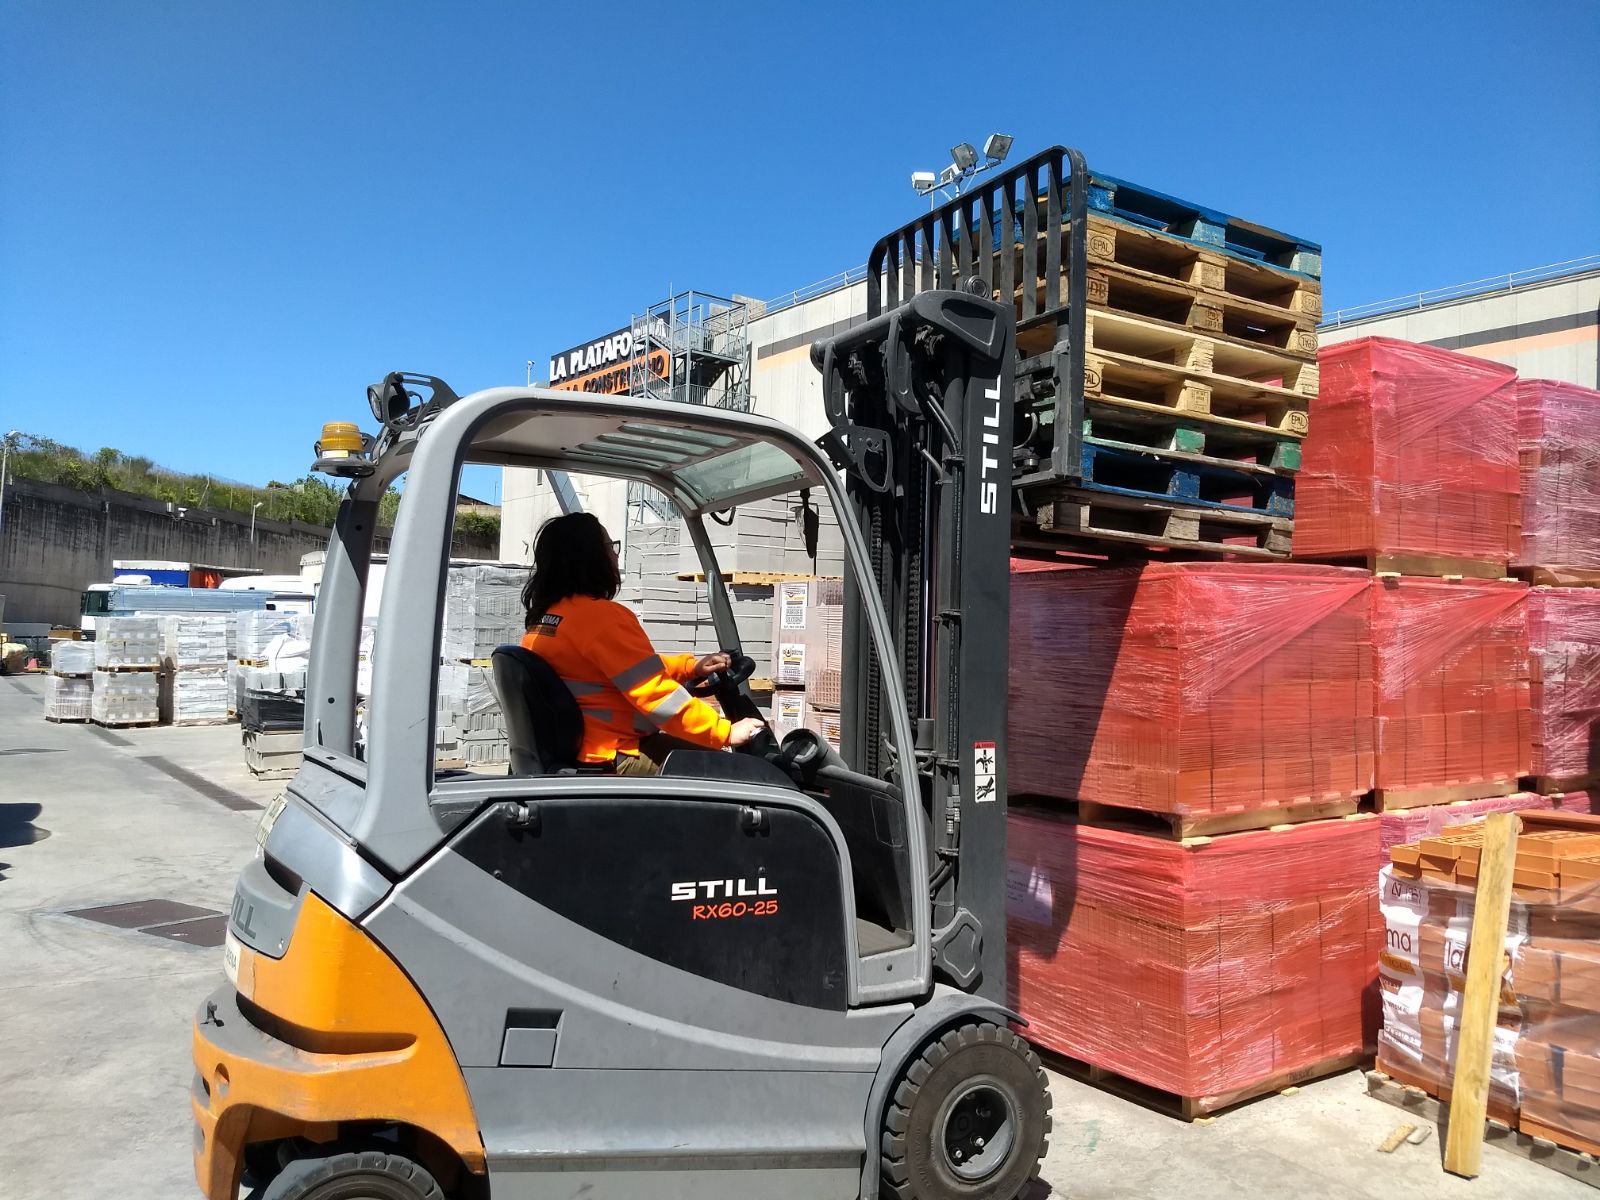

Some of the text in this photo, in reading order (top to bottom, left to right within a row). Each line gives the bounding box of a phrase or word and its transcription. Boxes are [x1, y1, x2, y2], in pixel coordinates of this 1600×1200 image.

[1093, 238, 1110, 253] EPAL
[550, 357, 567, 381] LA
[1291, 414, 1305, 427] EPAL
[981, 375, 1001, 514] STILL
[671, 877, 778, 901] STILL
[692, 900, 779, 920] RX60-25
